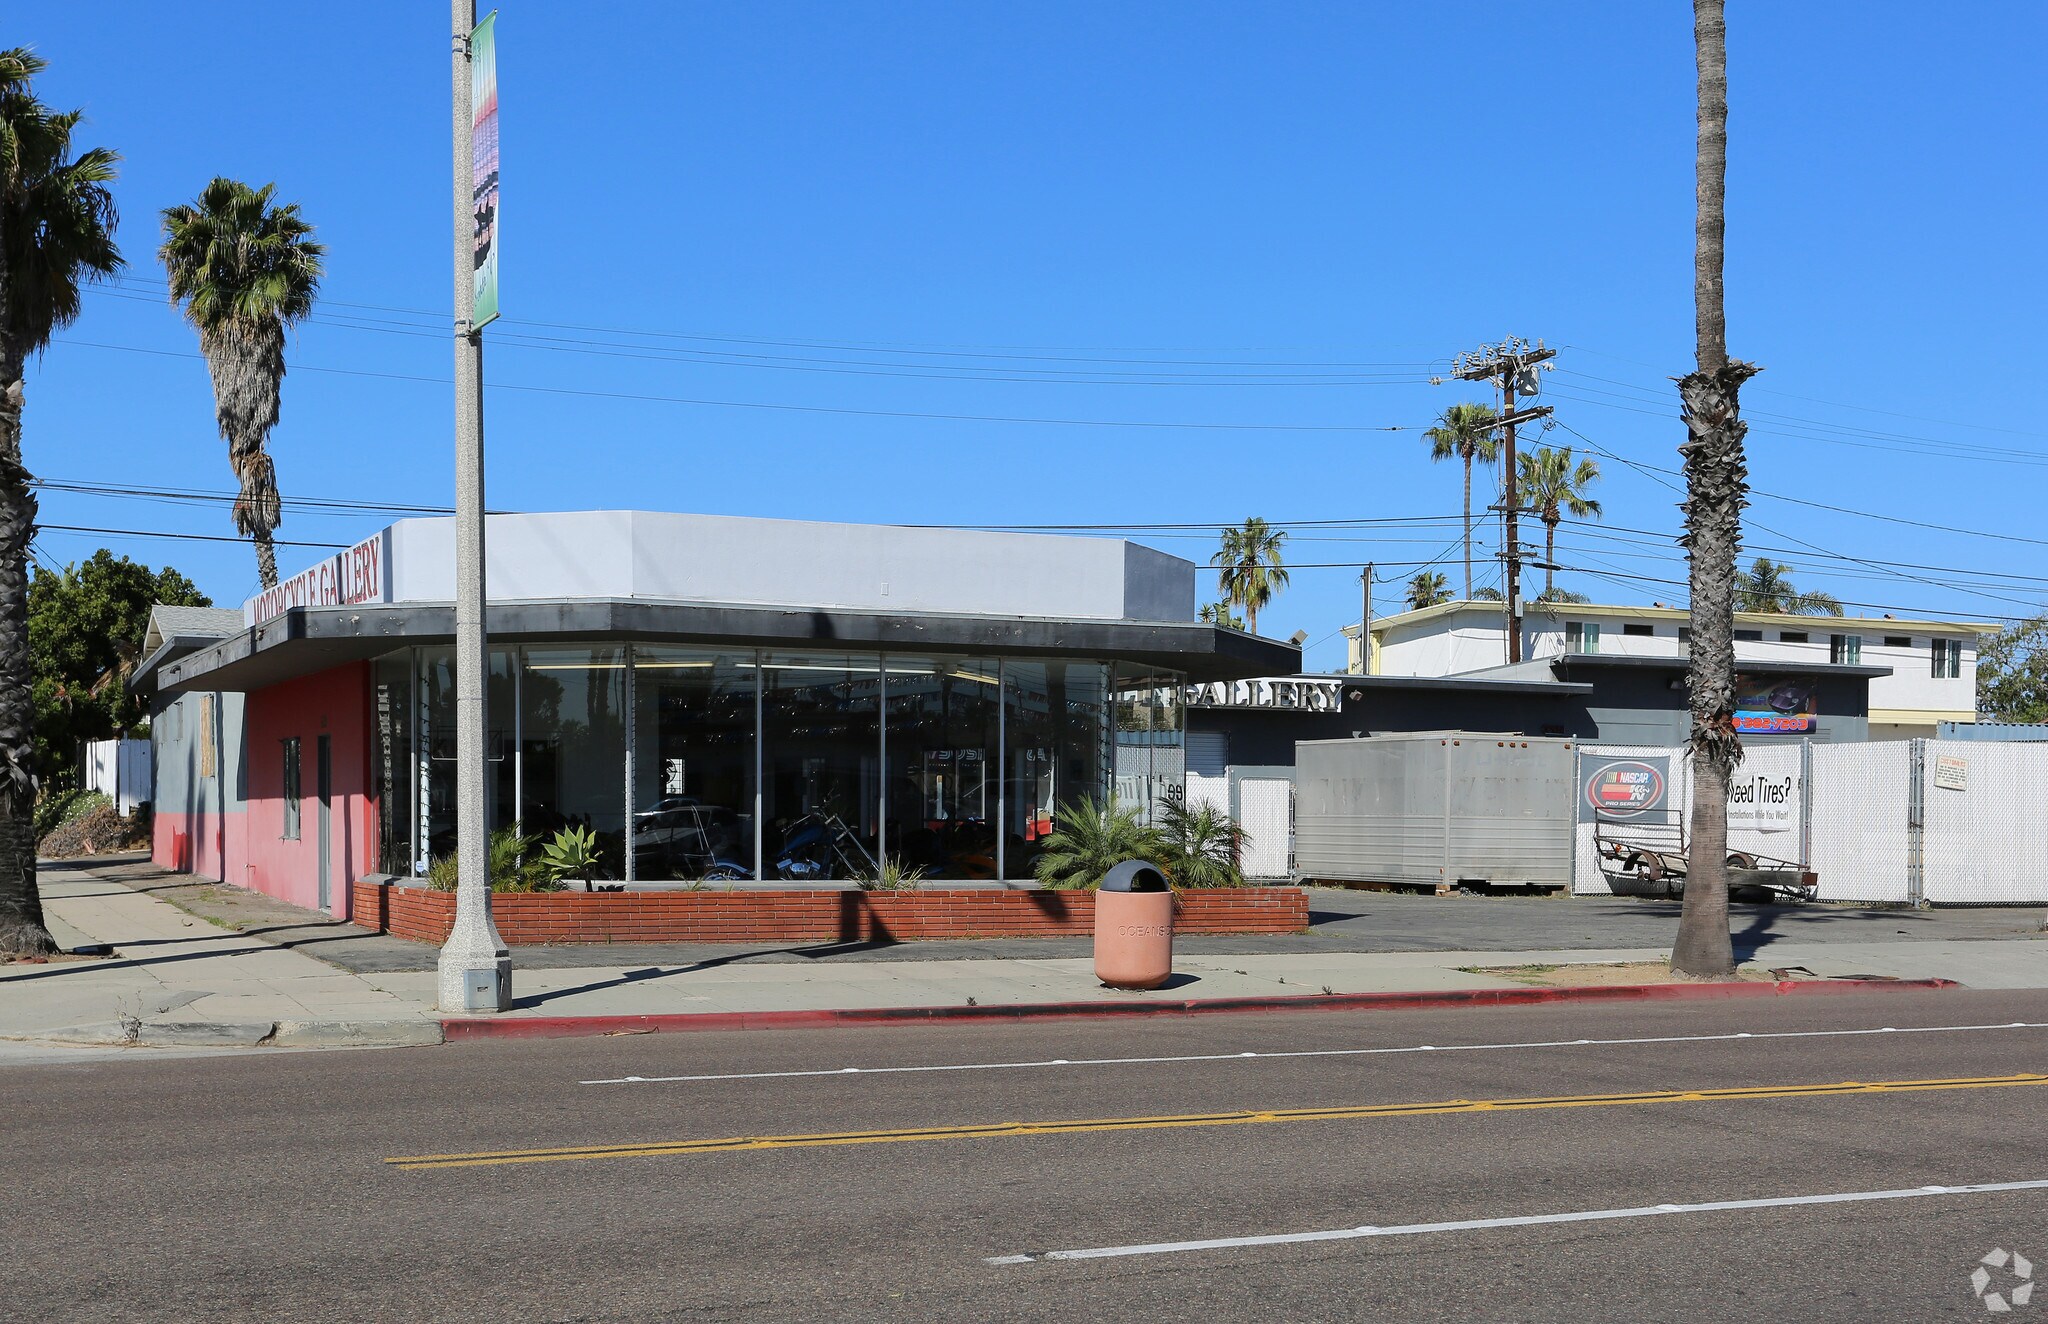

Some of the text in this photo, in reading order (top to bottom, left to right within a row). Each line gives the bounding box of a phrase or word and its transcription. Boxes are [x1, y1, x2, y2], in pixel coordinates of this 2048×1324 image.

[253, 537, 379, 623] MOTORCYCLE GALLERY
[1177, 680, 1345, 712] GALLERY
[1620, 771, 1649, 783] NASCAR
[1757, 776, 1791, 803] Tires?
[1766, 810, 1774, 819] You
